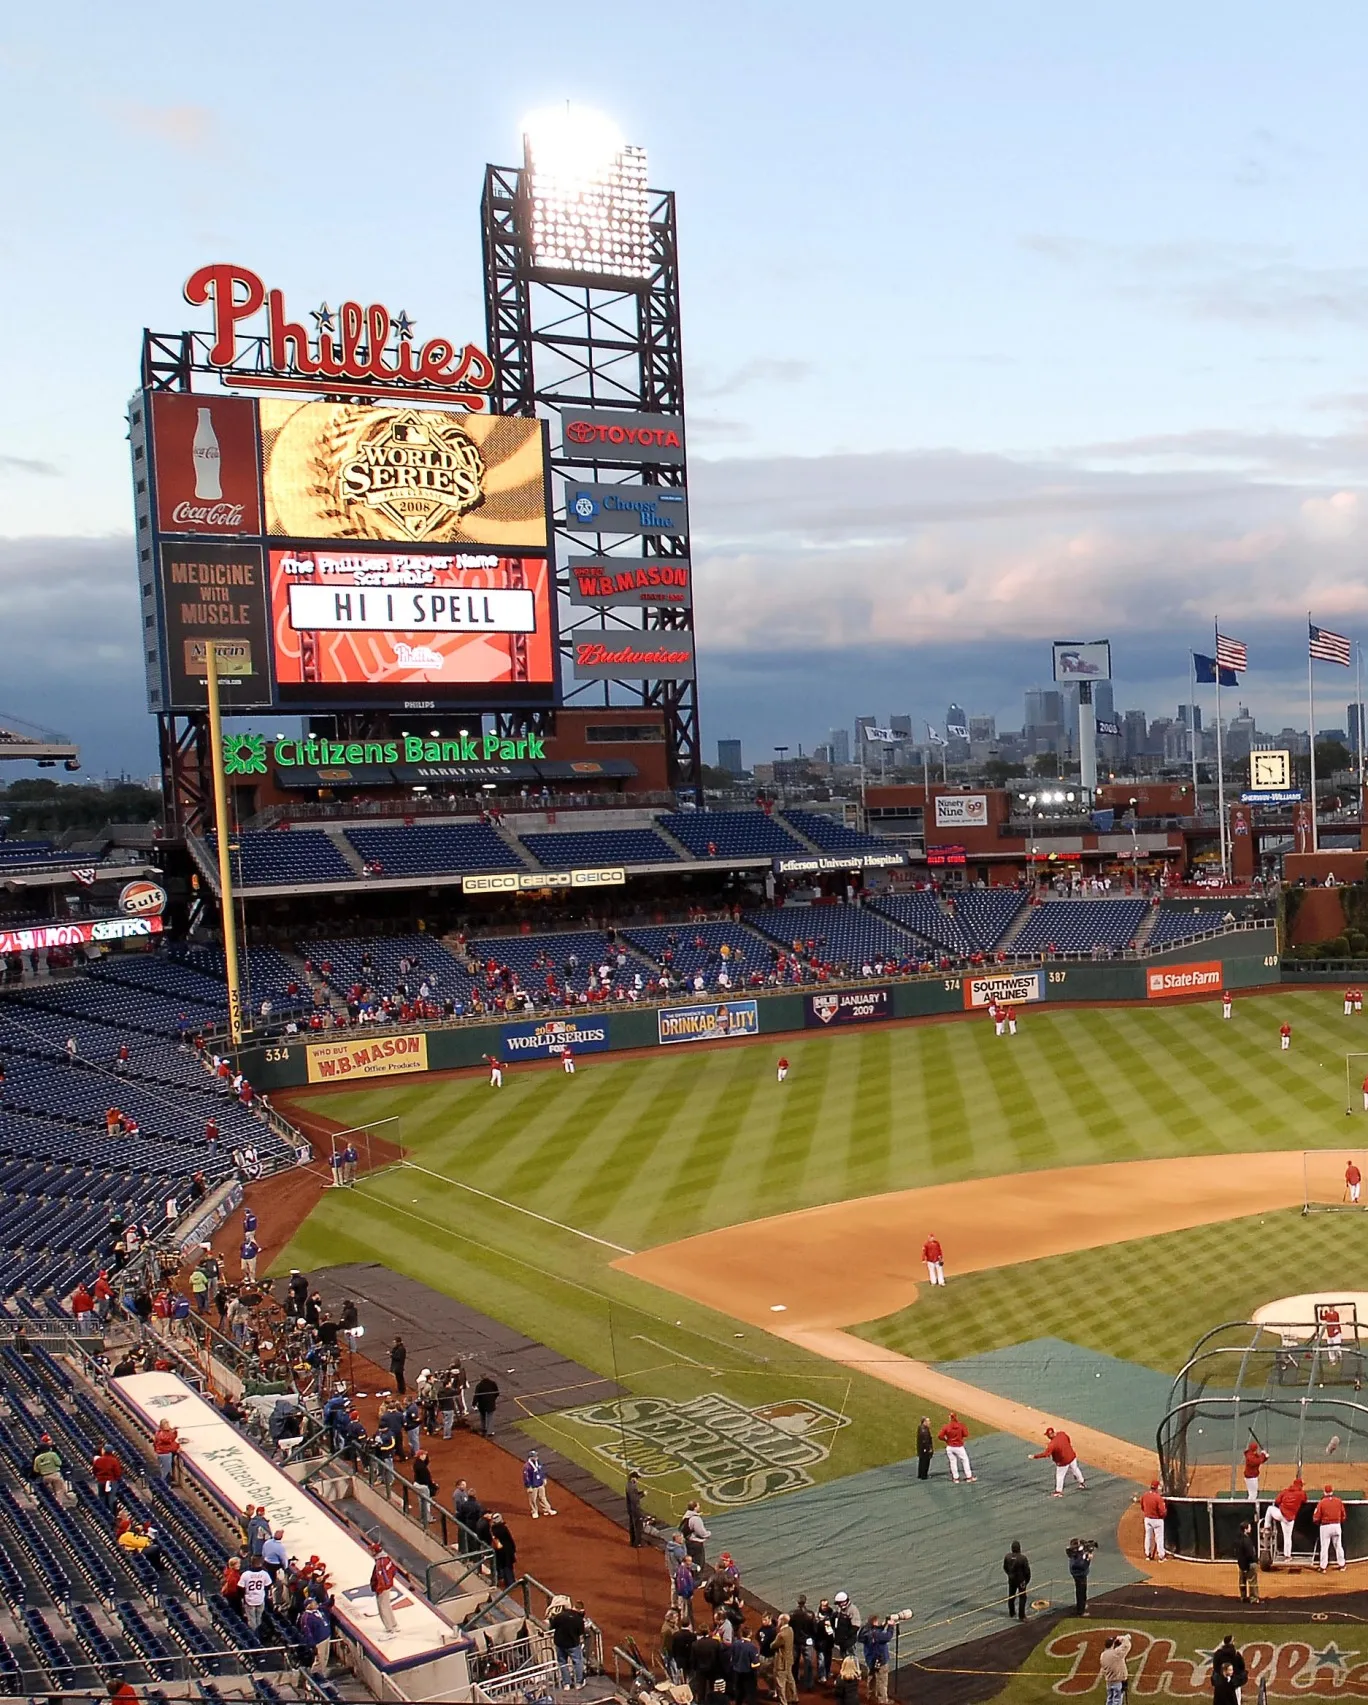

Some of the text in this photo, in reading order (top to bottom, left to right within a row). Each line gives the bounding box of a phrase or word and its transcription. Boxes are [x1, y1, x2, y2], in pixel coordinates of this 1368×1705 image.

[184, 264, 494, 389] Phillies
[595, 425, 680, 448] TOYOTA
[363, 447, 458, 471] WORLD
[343, 461, 477, 498] SERIES
[400, 502, 430, 512] 2008
[603, 496, 656, 512] Choose
[172, 501, 245, 525] Coca-Cola
[281, 553, 499, 574] The Phillies Player Name
[354, 570, 436, 586] Scramble
[181, 603, 250, 624] MUSCLE
[335, 593, 495, 623] HI I SPELL
[191, 643, 245, 657] Mtrin
[576, 643, 690, 666] Budweiser
[404, 701, 435, 709] PHILIPS
[274, 733, 546, 766] Citizens Bank Park
[417, 767, 467, 777] HARRY
[488, 765, 512, 775] K'S
[938, 799, 964, 809] Ninety
[938, 808, 963, 816] Nine
[968, 802, 982, 812] 99
[779, 854, 904, 872] Jefferson University Hospitals
[465, 872, 623, 889] GEICO GEICO GEICO
[124, 891, 162, 911] Gulf
[1264, 955, 1279, 967] 409
[973, 976, 1037, 993] SOUTHWEST
[1049, 971, 1066, 983] 387
[944, 980, 960, 991] 374
[840, 992, 887, 1006] JANUARY 1
[983, 989, 1028, 1002] AIRLINES
[231, 990, 241, 1032] 329
[853, 1006, 874, 1016] 2009
[535, 1026, 546, 1036] 20
[507, 1029, 605, 1050] WORLD SERIES
[265, 1048, 290, 1062] 334
[312, 1046, 348, 1057] WHO BUT
[364, 1061, 420, 1073] Office Products
[680, 1398, 826, 1467] WORLD
[588, 1398, 808, 1505] SERIES
[603, 1438, 684, 1474] 2008
[219, 1458, 305, 1527] Citizens Bank Park
[248, 1580, 263, 1591] 26
